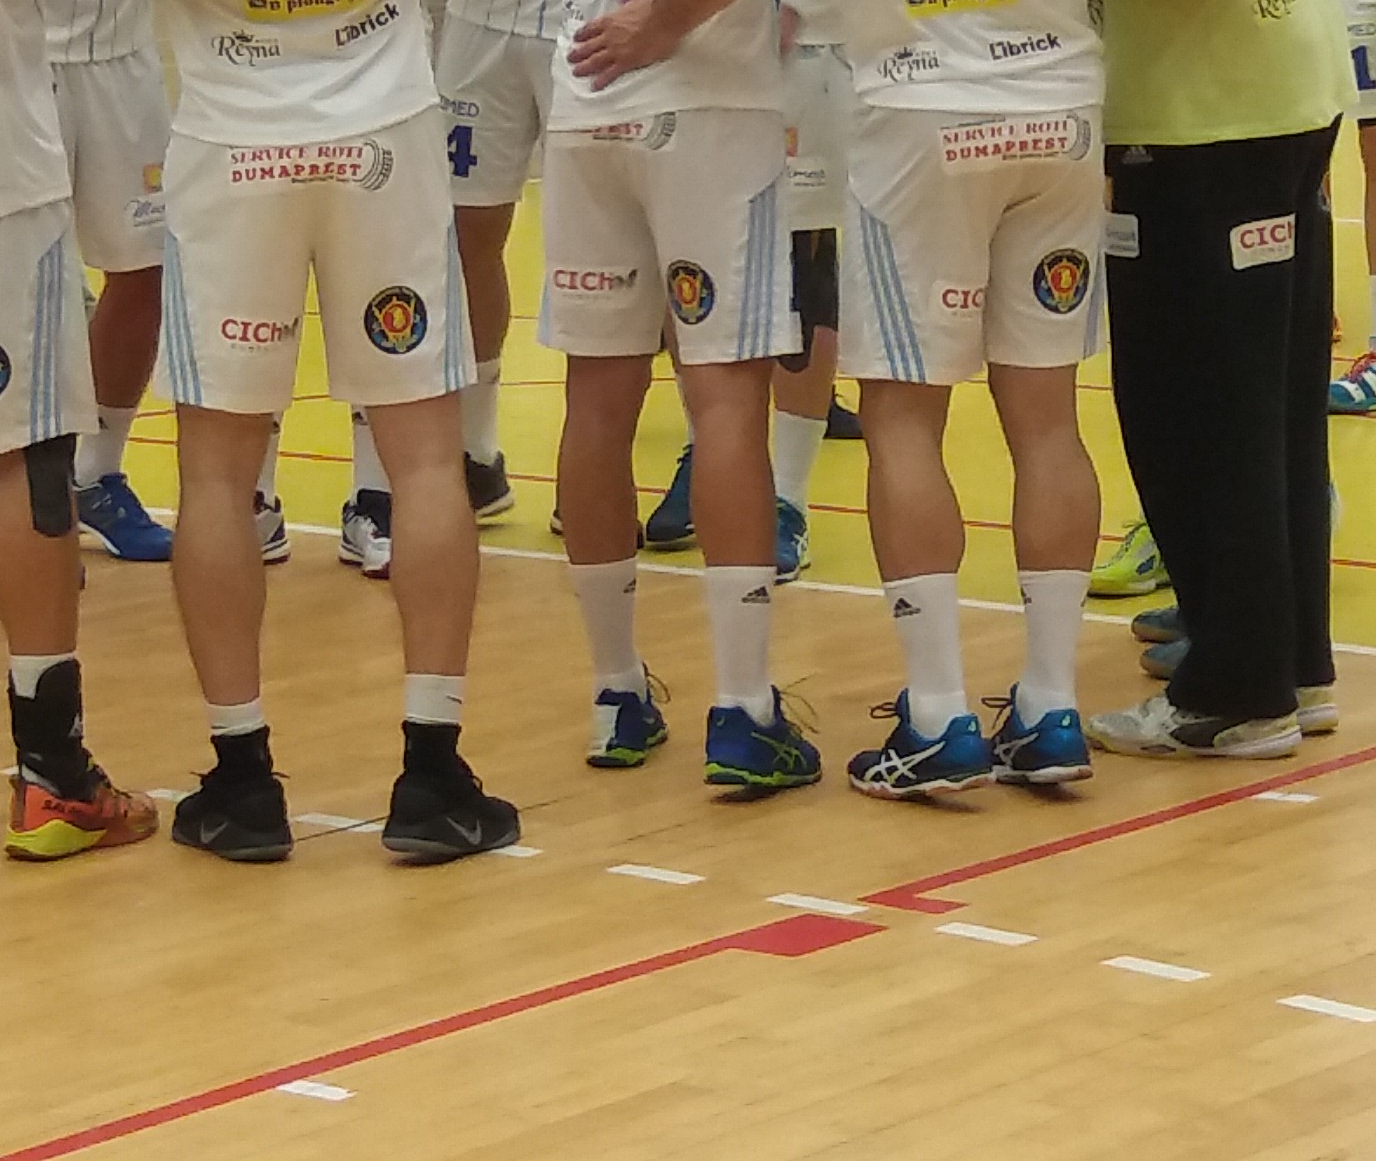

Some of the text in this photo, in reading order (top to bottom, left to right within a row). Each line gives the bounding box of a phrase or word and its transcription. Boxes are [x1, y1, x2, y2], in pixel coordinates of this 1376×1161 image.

[212, 35, 281, 67] Reyna
[945, 136, 1068, 163] DUMAPREST
[231, 161, 362, 184] DUMAPREST
